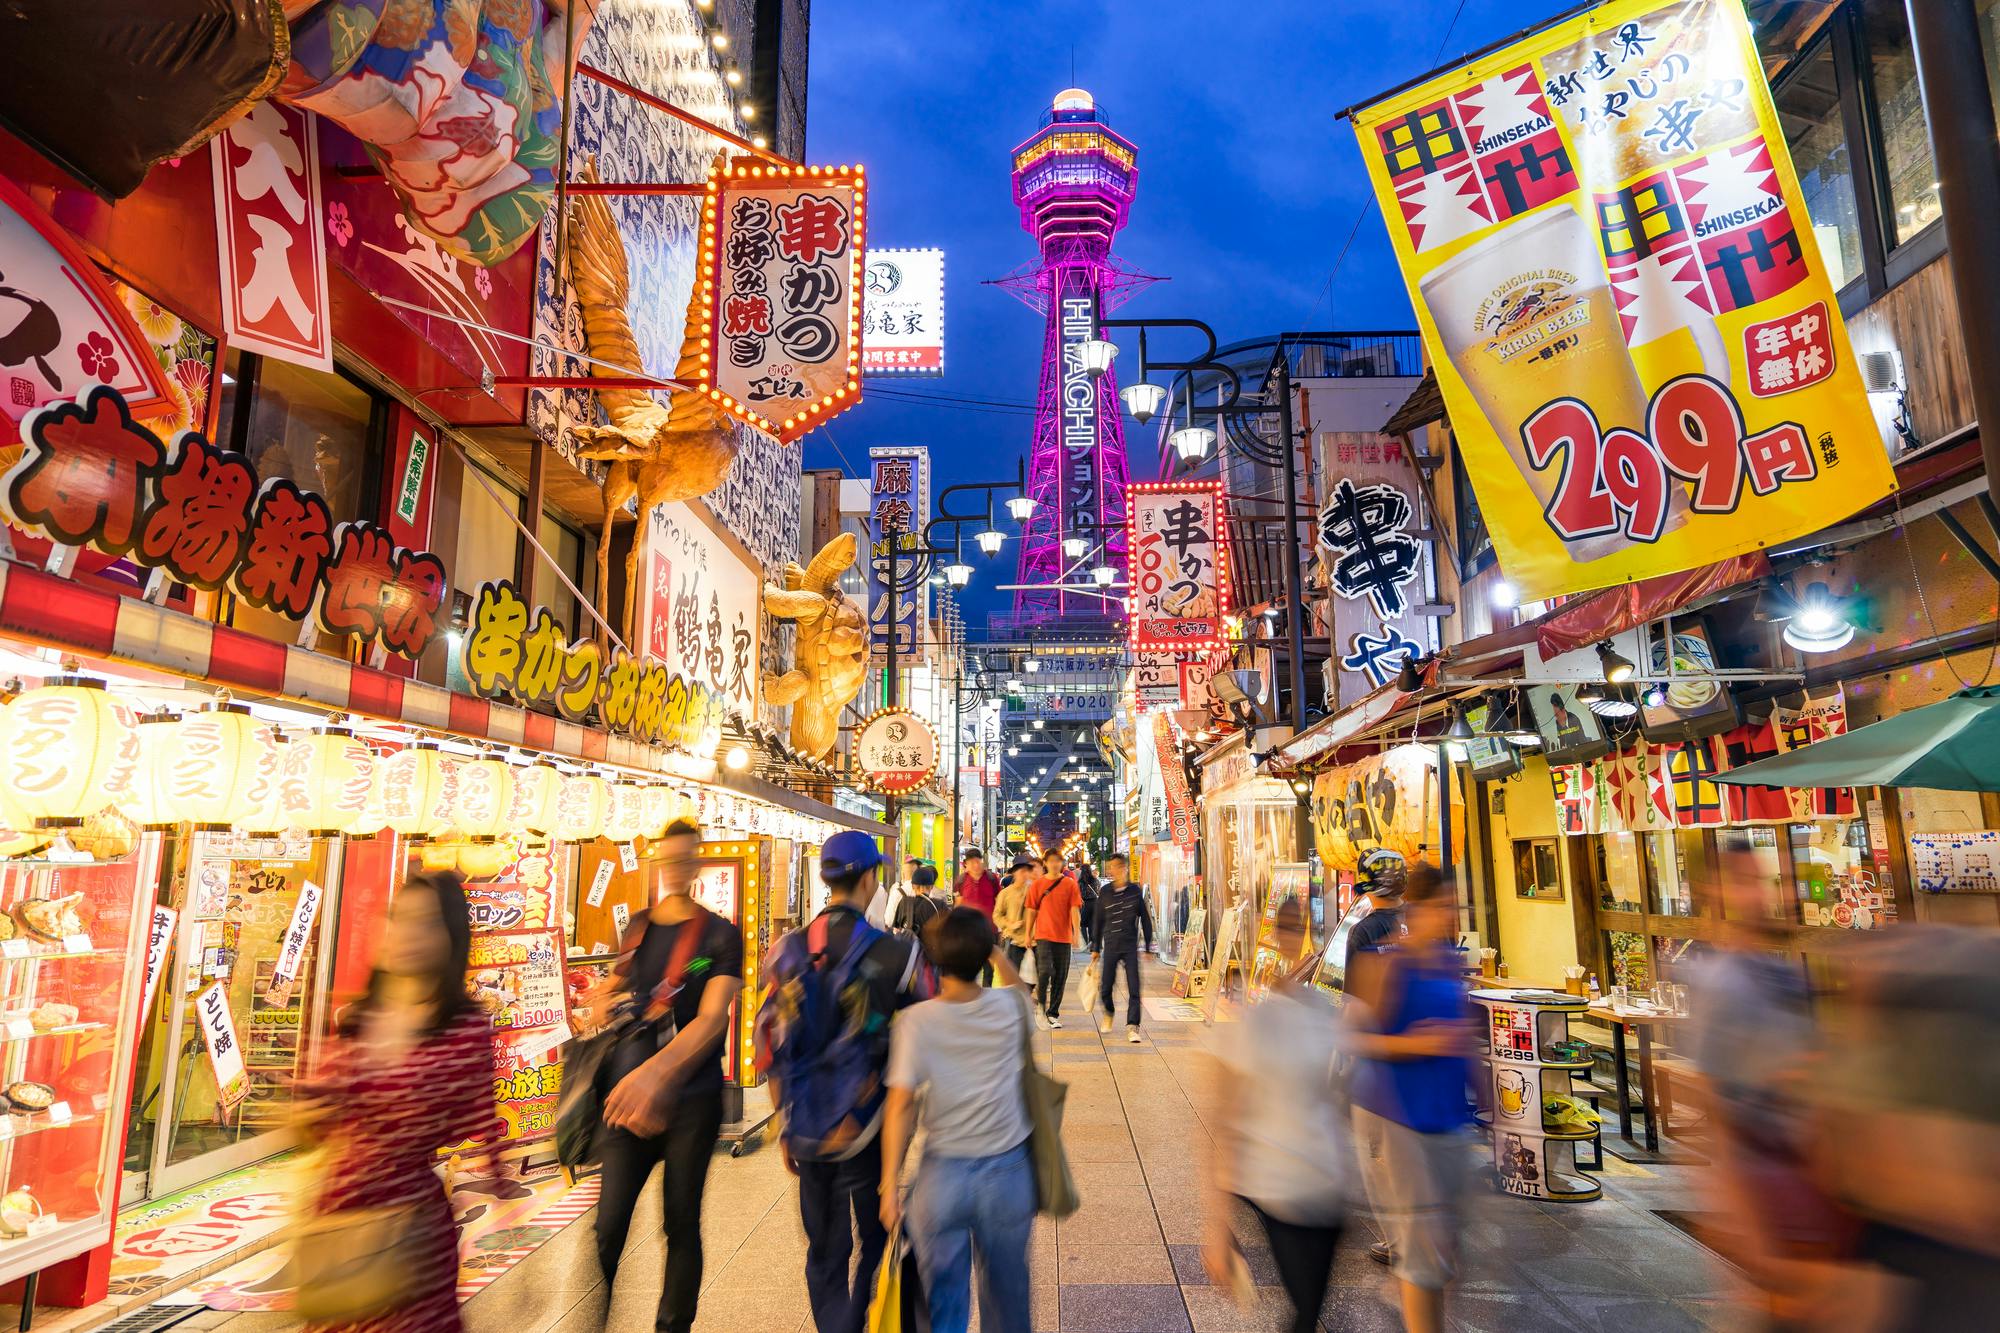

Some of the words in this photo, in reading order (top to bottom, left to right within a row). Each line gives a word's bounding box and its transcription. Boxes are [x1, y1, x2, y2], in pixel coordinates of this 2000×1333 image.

[1546, 22, 1656, 107] 新世界
[722, 197, 774, 367] お好み焼き
[775, 193, 847, 363] 串かつ
[1499, 327, 1545, 359] KIRIN
[1546, 308, 1588, 334] BEER
[1527, 333, 1579, 364] 一番搾り
[1754, 314, 1821, 357] 年中
[1758, 349, 1828, 390] 無休
[1338, 442, 1403, 465] 新世界
[874, 458, 913, 533] 麻雀
[1160, 500, 1212, 606] 串かつ
[652, 564, 668, 653] 名代
[672, 571, 753, 704] 鶴亀家
[871, 559, 915, 655] マルコ
[173, 722, 222, 799] ミックス
[336, 746, 373, 812] ミックス
[203, 986, 232, 1058] どて焼
[513, 1009, 563, 1028] 1,500円
[1494, 1047, 1534, 1062] ¥299
[1501, 1177, 1541, 1197] OYAJI
